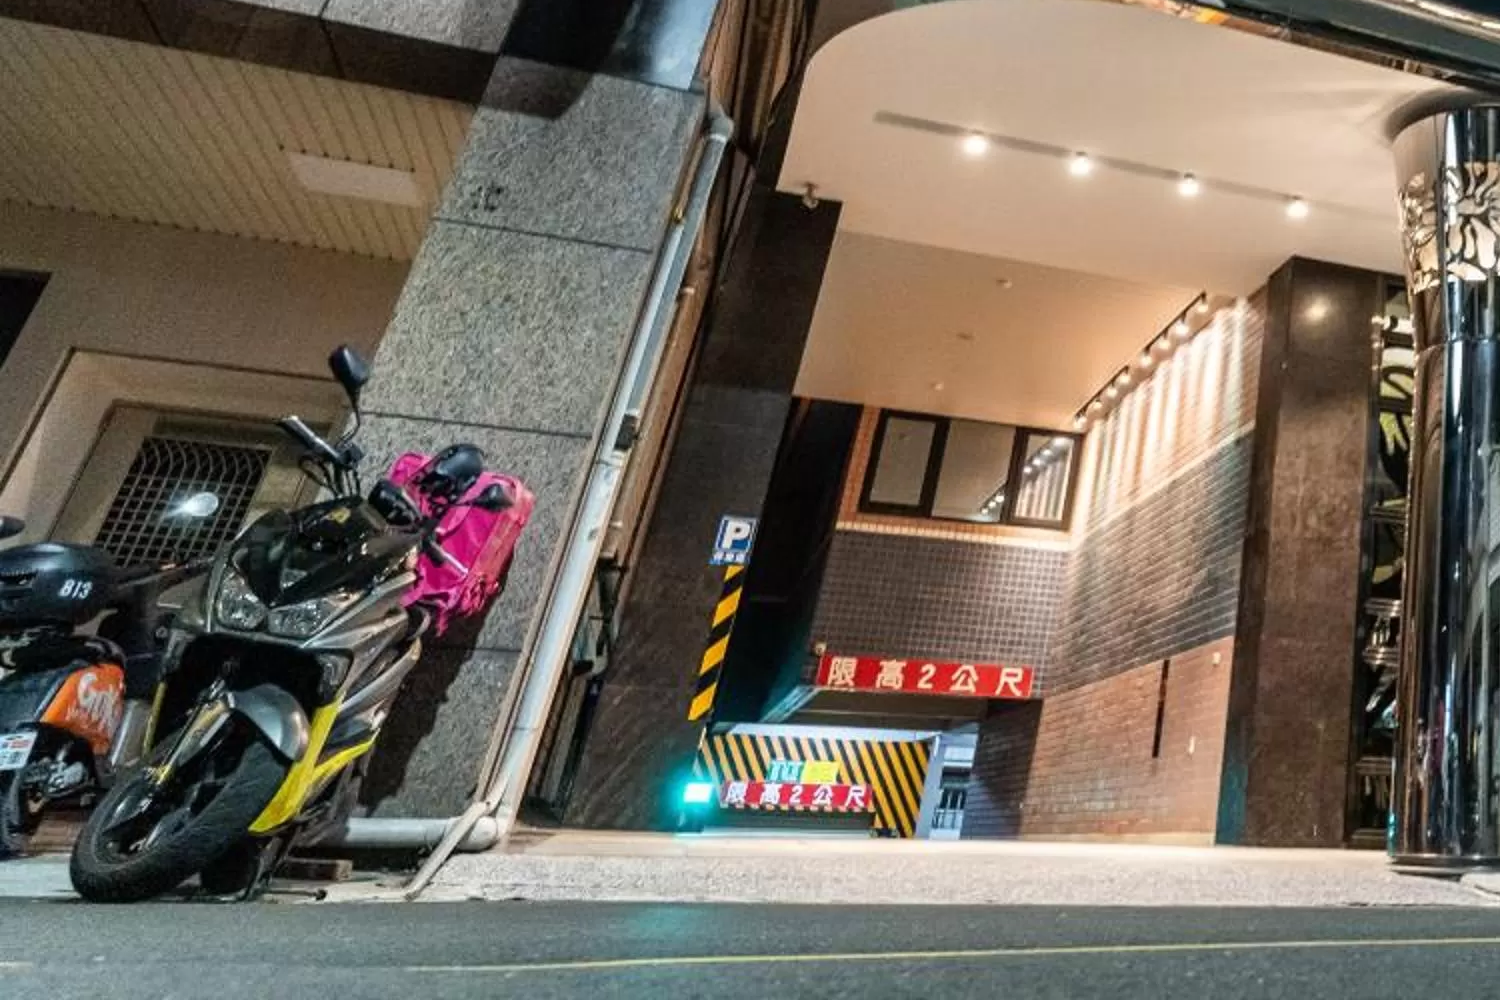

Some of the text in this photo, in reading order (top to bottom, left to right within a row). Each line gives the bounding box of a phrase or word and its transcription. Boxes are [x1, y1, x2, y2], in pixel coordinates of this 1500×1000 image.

[722, 521, 751, 550] P
[58, 579, 93, 599] 813
[826, 656, 1024, 697] 限高2公尺
[726, 781, 866, 809] 限高2公尺
